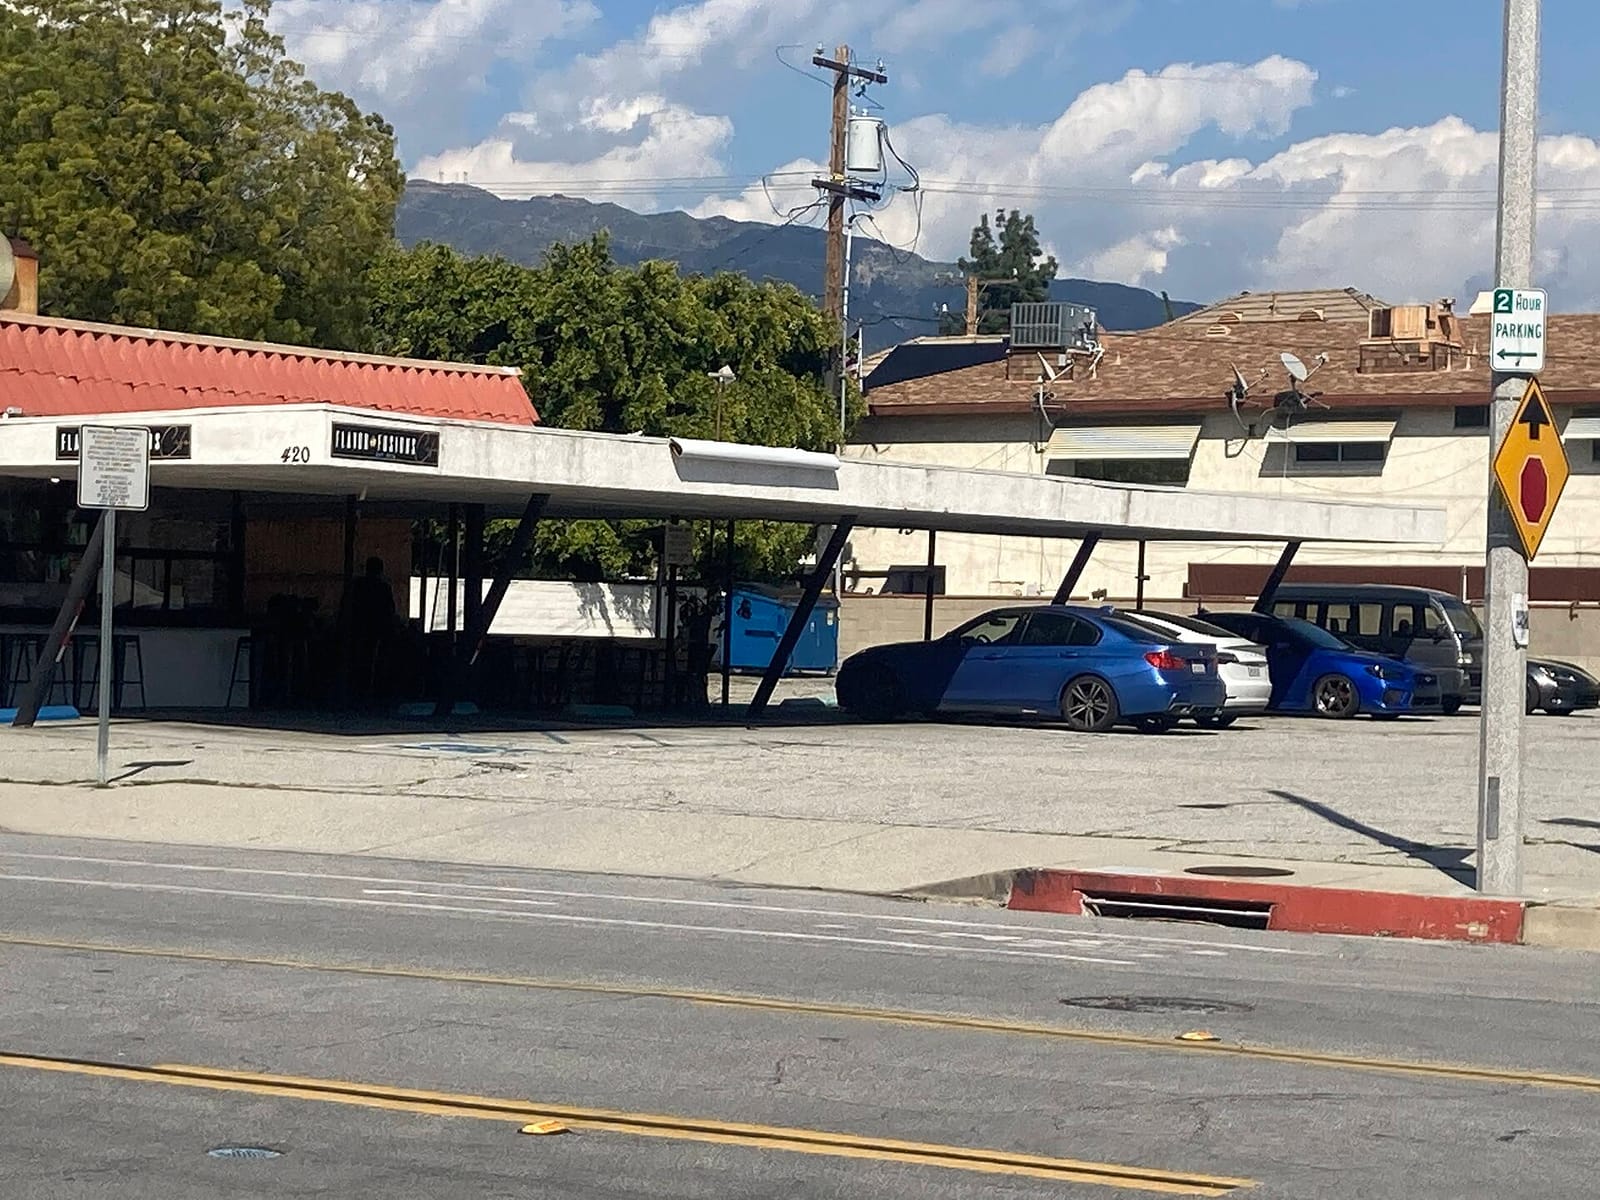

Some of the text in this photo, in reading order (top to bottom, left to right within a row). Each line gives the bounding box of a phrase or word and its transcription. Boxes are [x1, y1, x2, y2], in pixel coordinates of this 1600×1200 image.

[1497, 293, 1542, 311] 2 HOUR
[1495, 323, 1542, 339] PARKING
[335, 429, 369, 450] FLAVOR
[281, 446, 310, 464] 420
